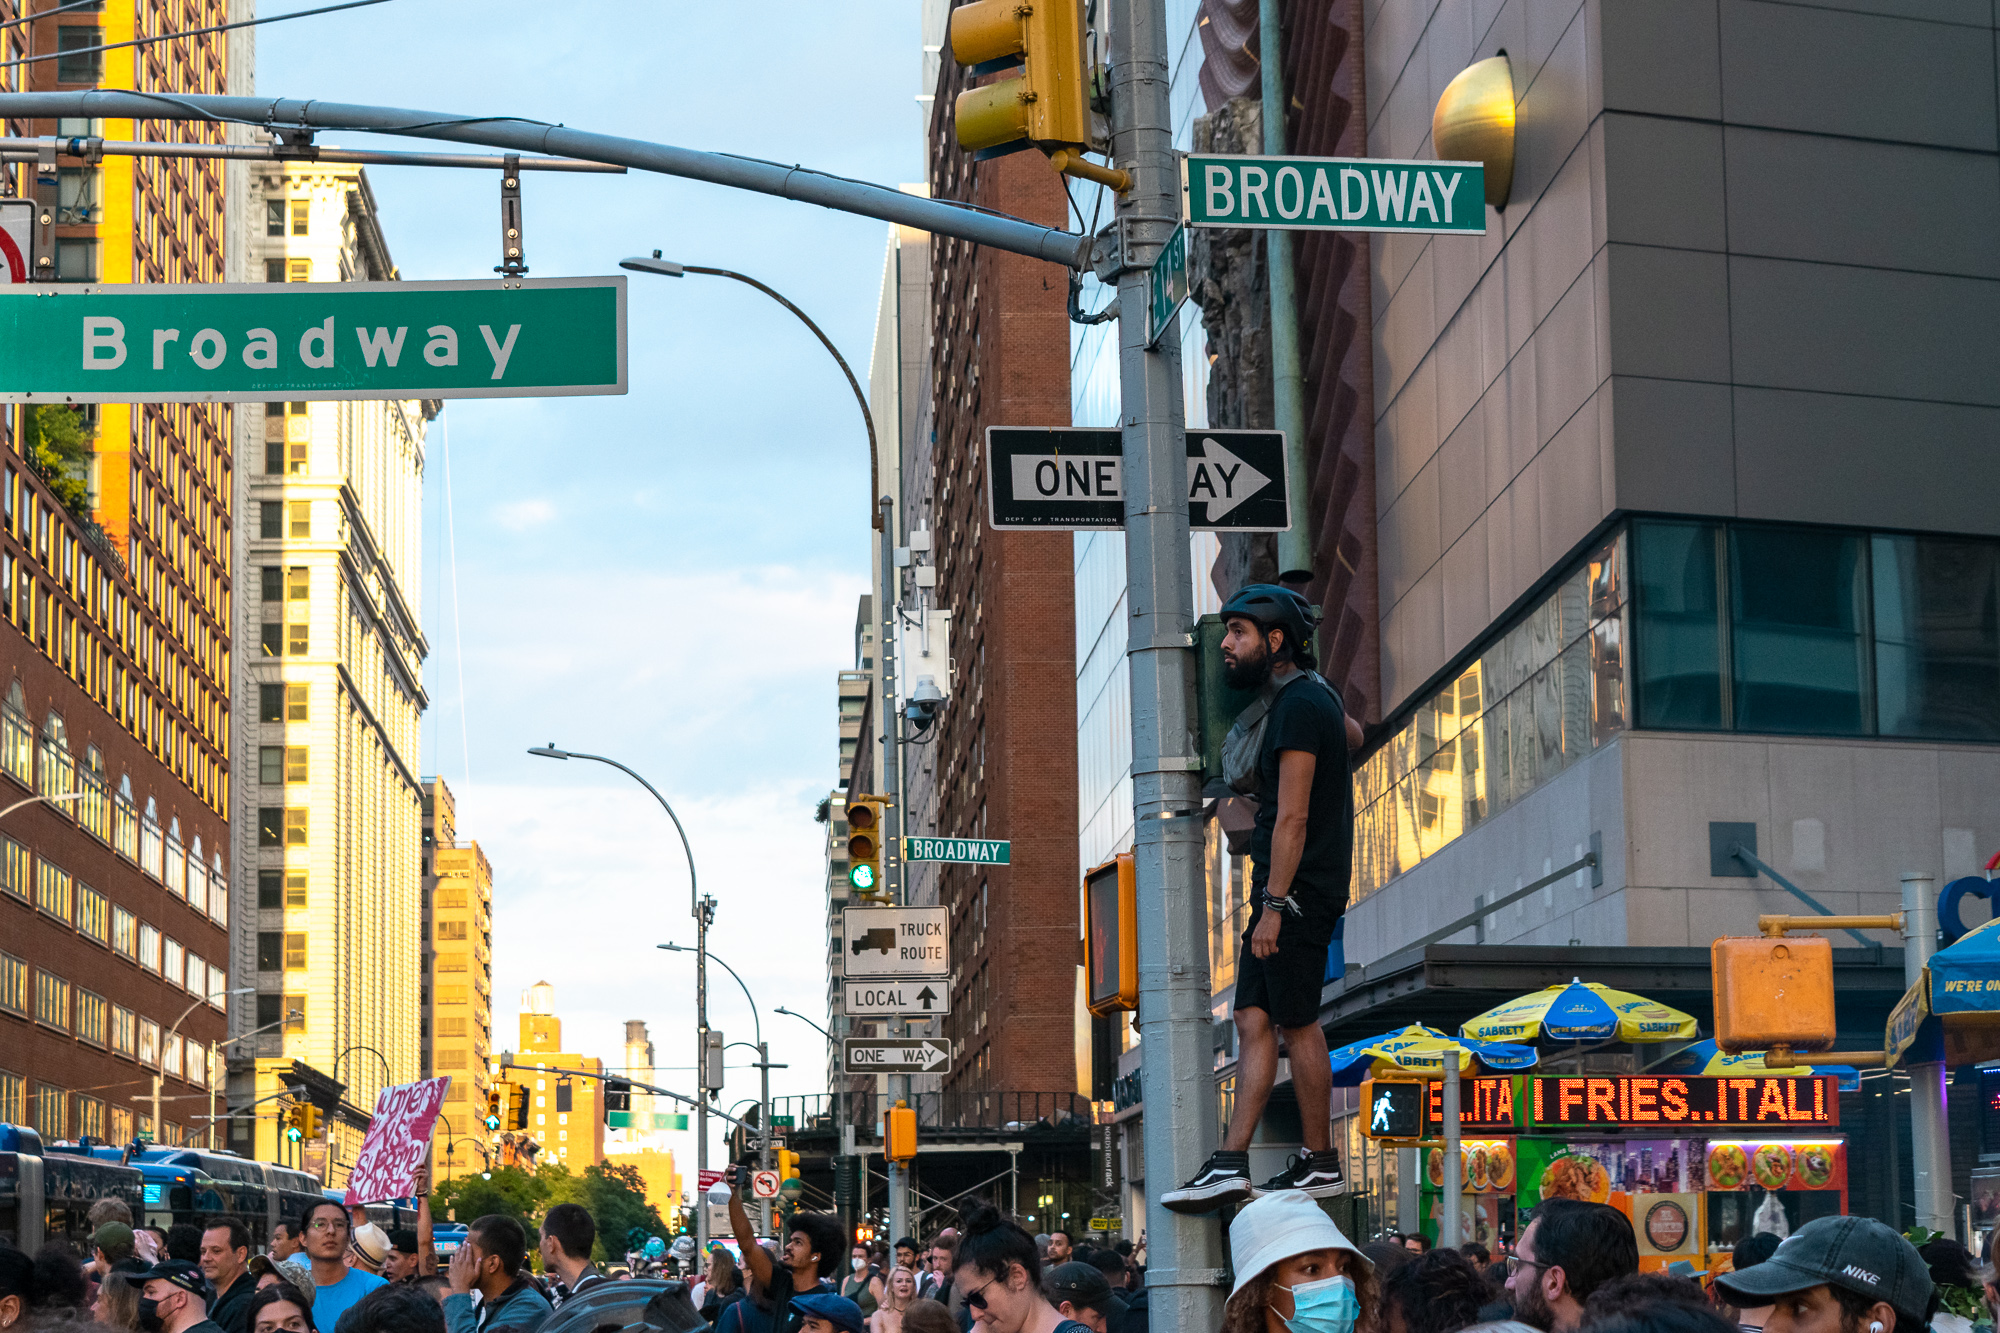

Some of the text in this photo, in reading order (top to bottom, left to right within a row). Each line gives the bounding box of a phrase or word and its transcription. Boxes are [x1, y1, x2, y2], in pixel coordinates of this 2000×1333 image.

[1204, 165, 1462, 223] BROADWAY
[82, 315, 522, 380] Broadway
[1035, 459, 1242, 499] ONE AY
[913, 839, 1001, 861] BROADWAY
[900, 923, 942, 936] TRUCK
[900, 947, 942, 960] ROUTE
[1945, 980, 1984, 993] WE'RE
[855, 989, 908, 1007] LOCAL
[1478, 1025, 1526, 1038] SABRETT
[1638, 1022, 1681, 1033] SABRETT
[854, 1049, 936, 1062] ONE WAY
[1104, 1125, 1112, 1168] NORDSTROM
[1105, 1168, 1115, 1187] rack
[1841, 1264, 1881, 1286] NIKE
